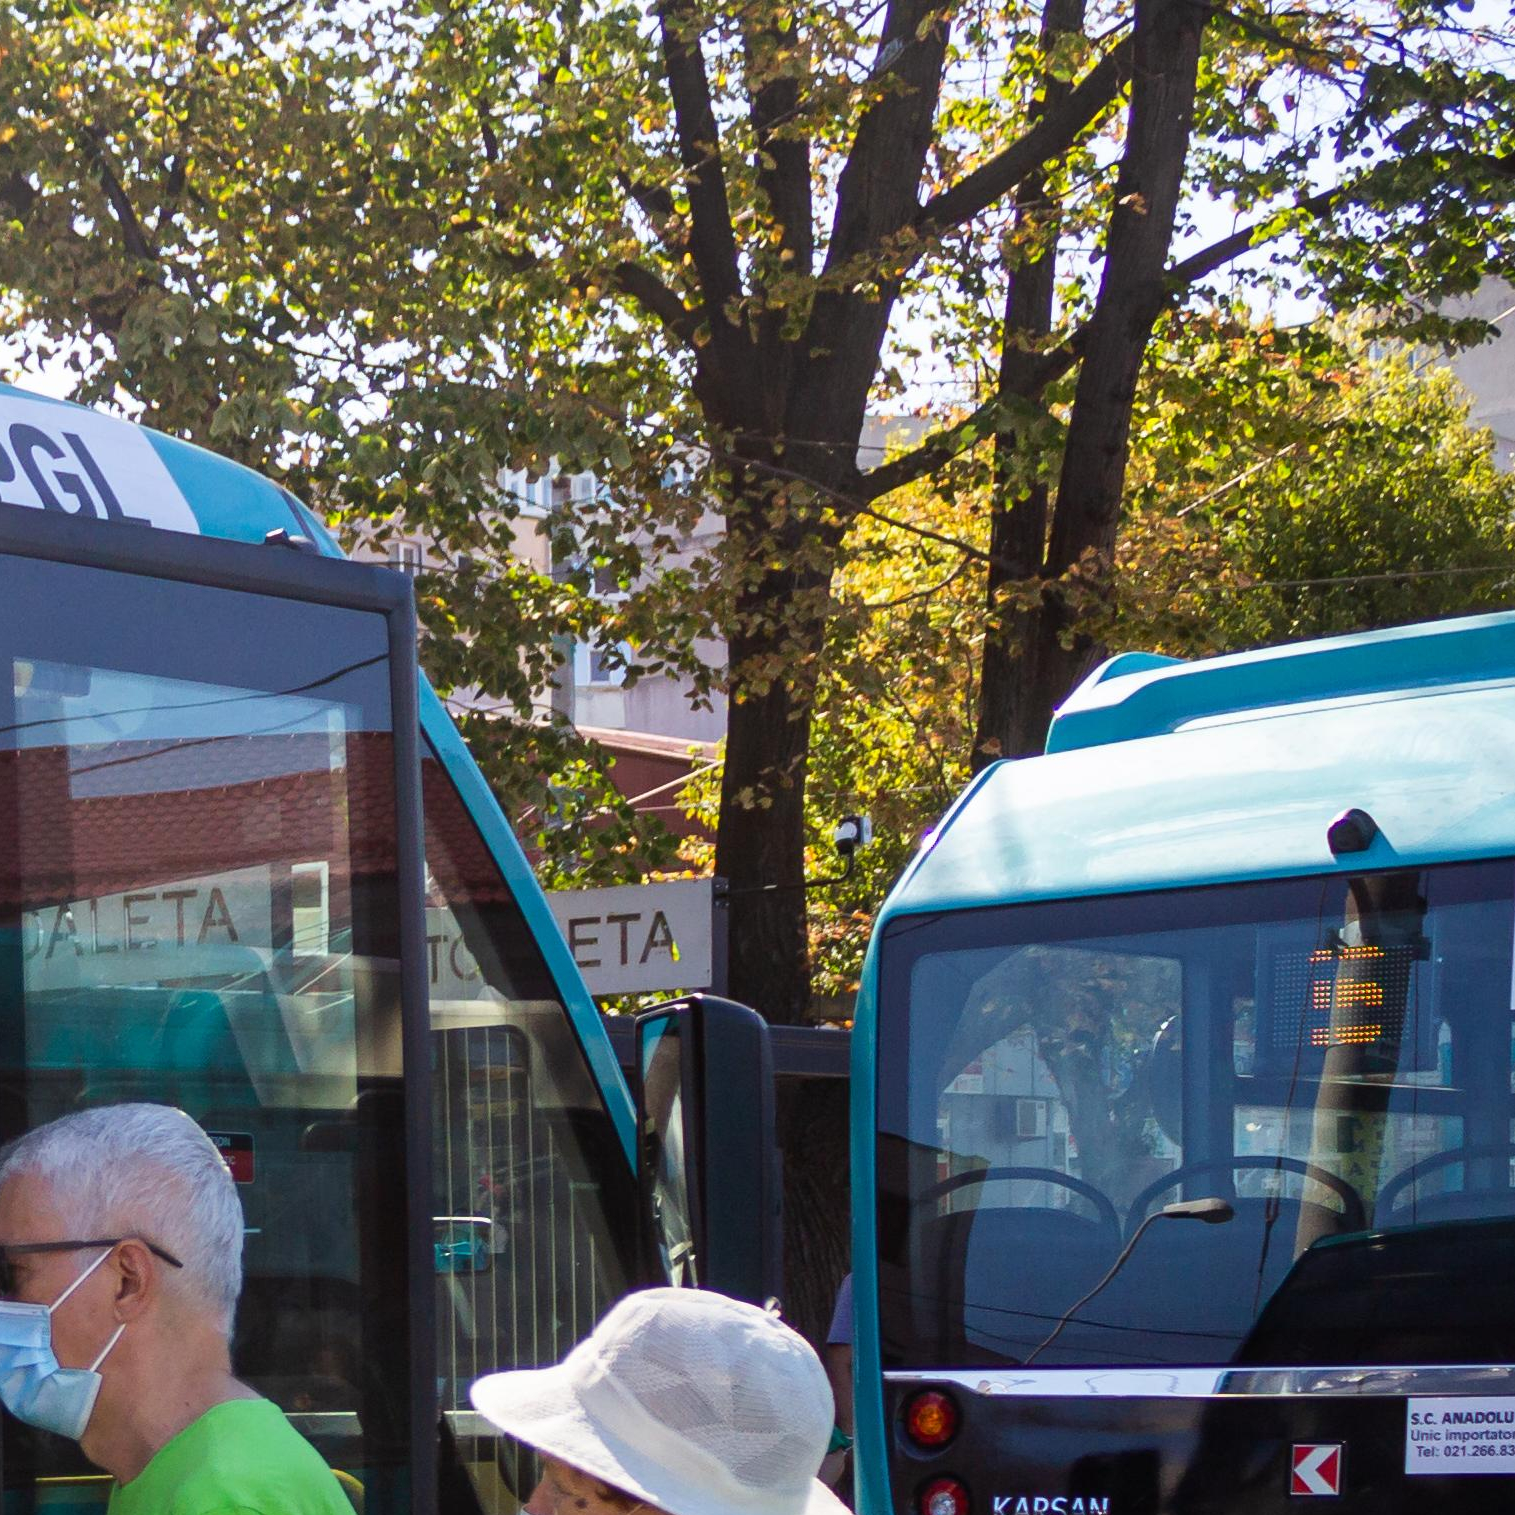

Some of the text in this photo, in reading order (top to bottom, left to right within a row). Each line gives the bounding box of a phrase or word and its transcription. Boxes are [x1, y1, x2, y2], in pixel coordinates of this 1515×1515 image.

[1411, 1411, 1515, 1425] S.C. ANADOLU
[1411, 1430, 1441, 1441] Unic
